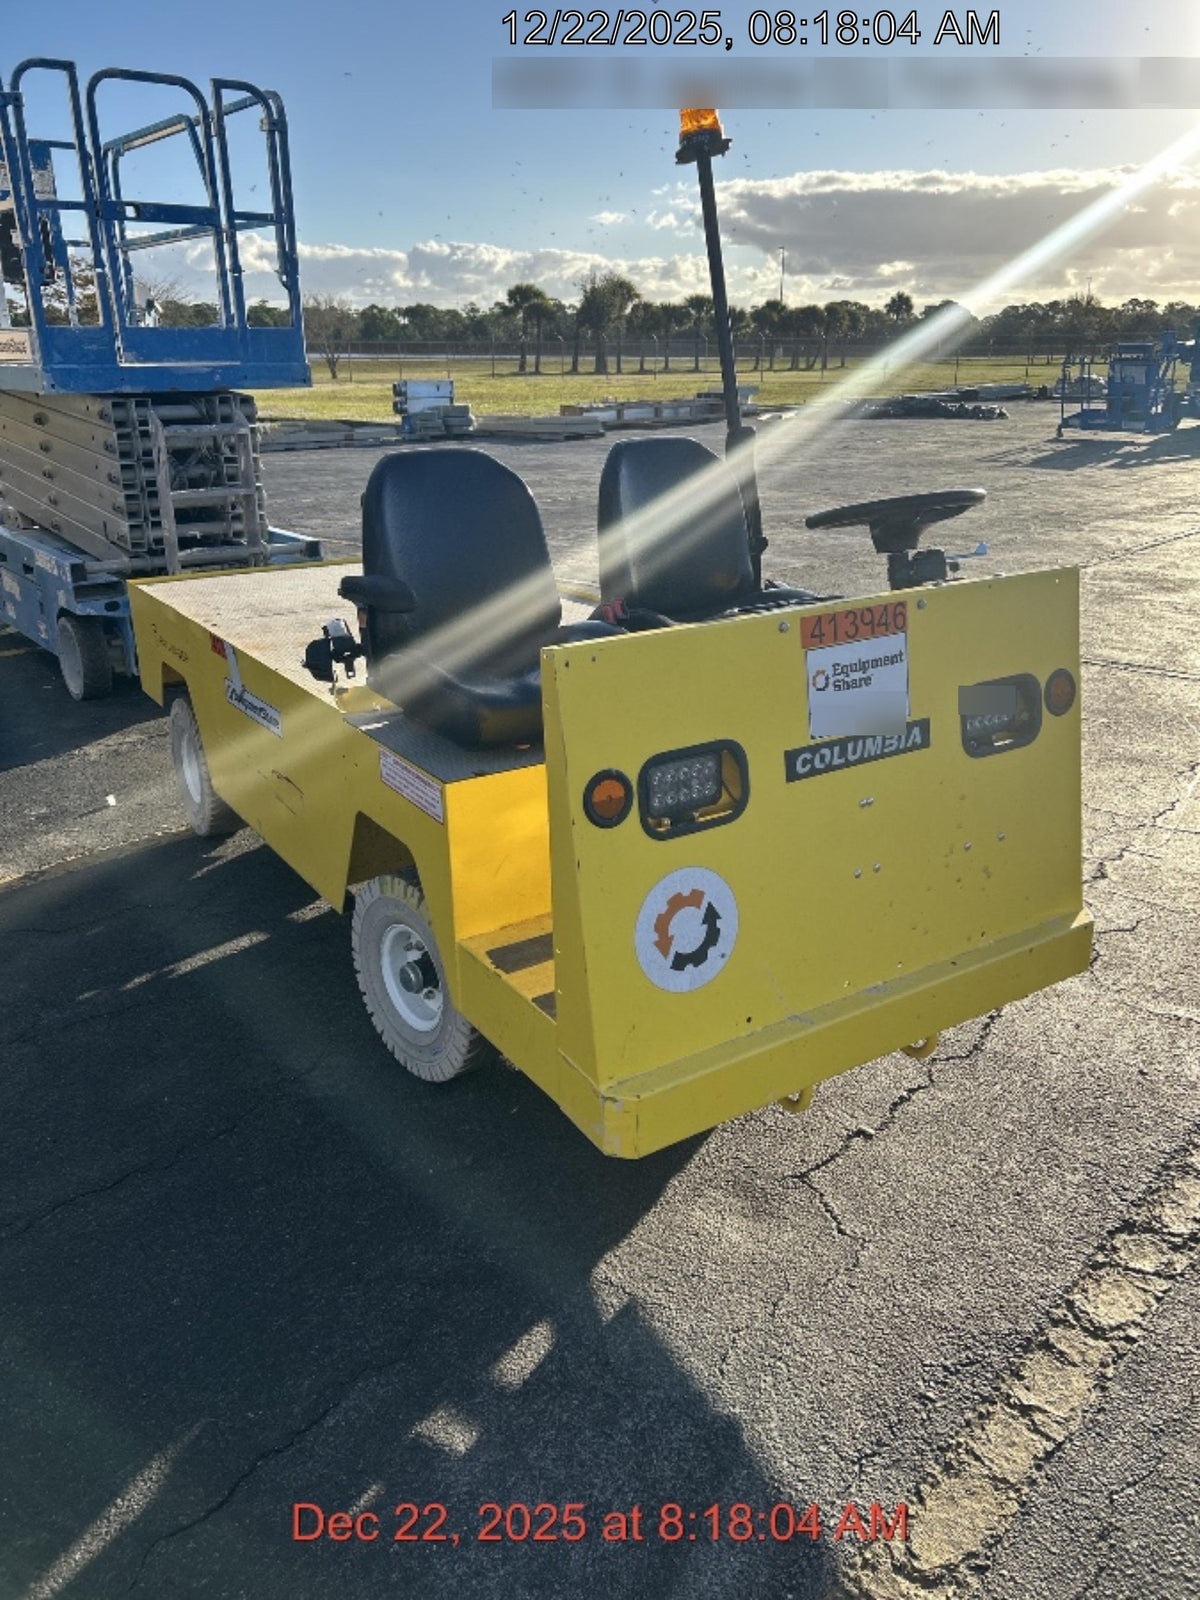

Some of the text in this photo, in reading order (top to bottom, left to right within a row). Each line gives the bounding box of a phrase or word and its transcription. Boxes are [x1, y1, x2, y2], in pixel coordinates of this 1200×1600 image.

[810, 603, 907, 644] 413946
[831, 649, 904, 678] Equipment
[832, 675, 872, 692] Share
[795, 726, 922, 774] COLUMBIA
